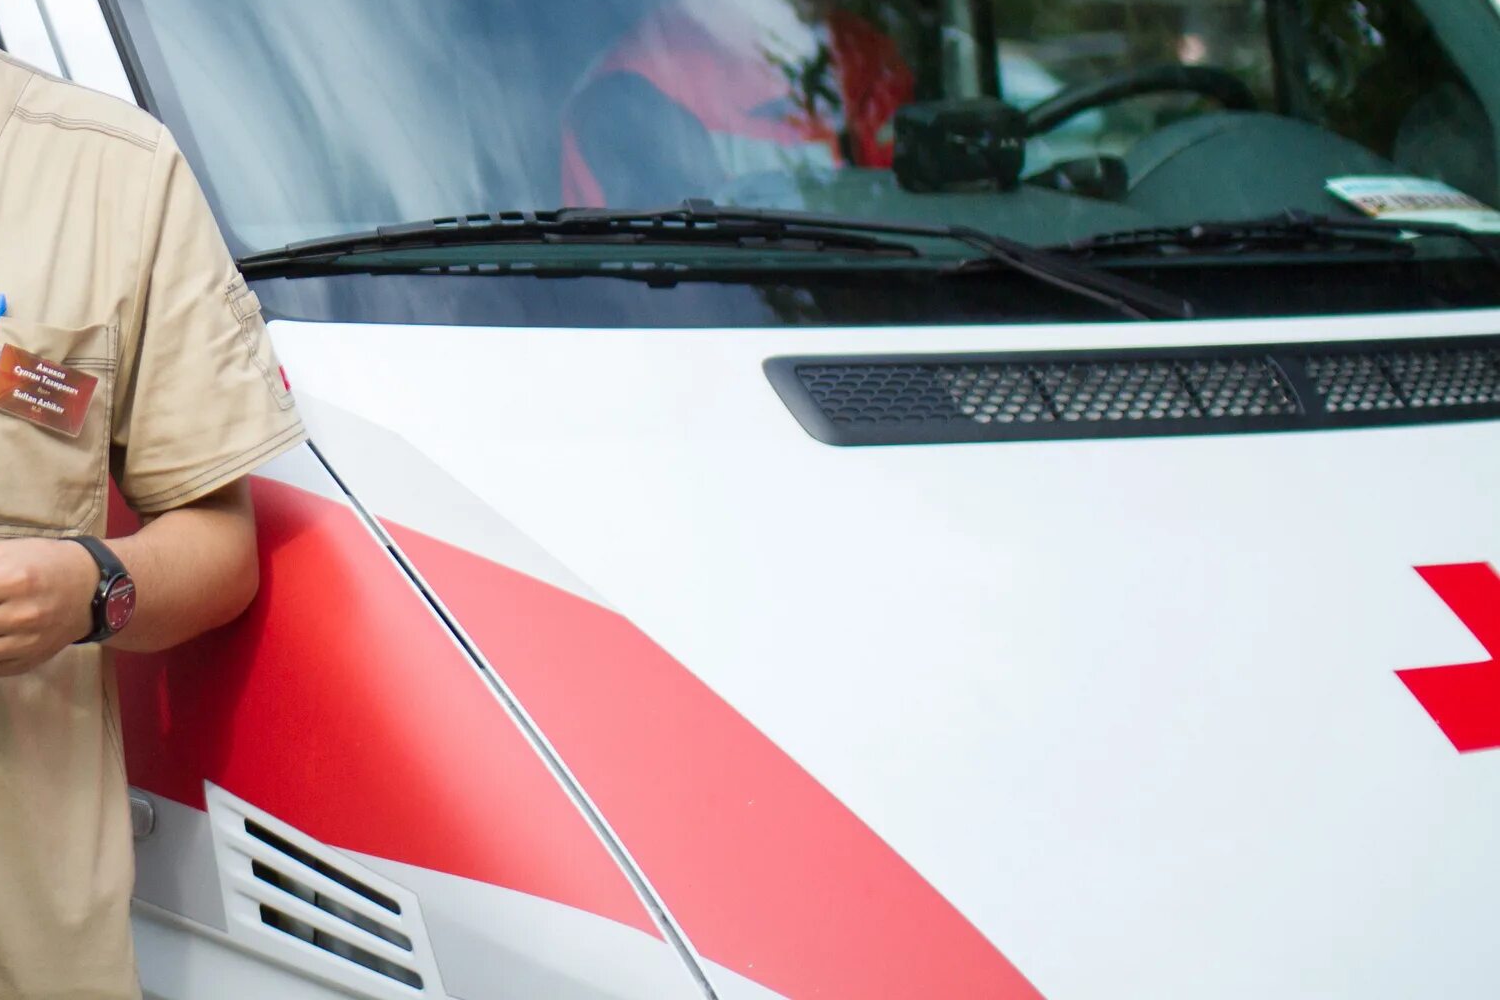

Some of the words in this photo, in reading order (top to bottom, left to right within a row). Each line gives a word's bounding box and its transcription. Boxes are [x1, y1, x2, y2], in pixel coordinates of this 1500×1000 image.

[13, 365, 41, 381] Султан
[41, 375, 79, 395] Тахирович
[36, 363, 66, 380] Ажиков
[12, 389, 37, 404] Sultan
[37, 398, 65, 414] Azhikov
